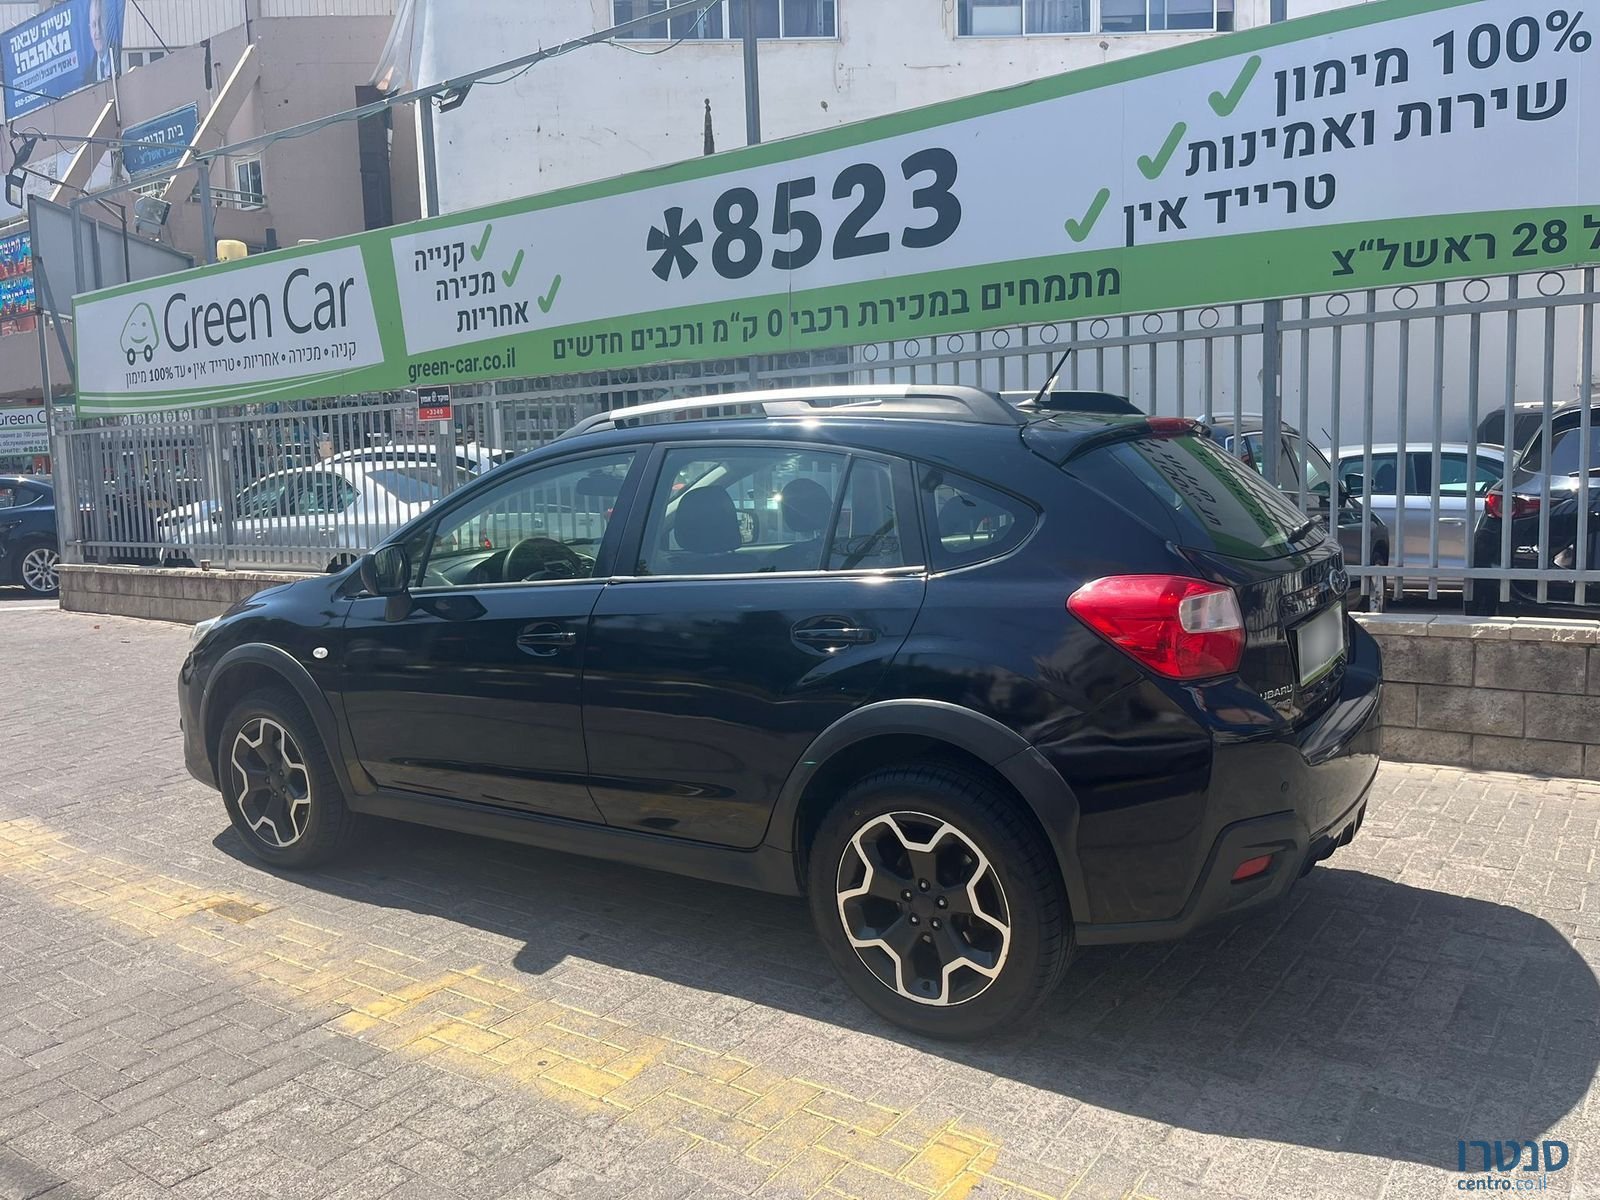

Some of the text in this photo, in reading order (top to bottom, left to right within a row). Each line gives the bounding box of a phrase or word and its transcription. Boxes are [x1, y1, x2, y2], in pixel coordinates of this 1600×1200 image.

[10, 8, 72, 53] עשייה שבאה
[14, 30, 72, 74] מאהבה!
[1274, 9, 1593, 117] 100% מימון
[1185, 78, 1568, 178] שירות ואמינות
[1123, 173, 1336, 248] טרייד אין
[415, 242, 465, 272] קנייה
[1512, 219, 1567, 257] 28
[436, 271, 495, 301] מכירה
[981, 267, 1120, 311] מתמחים
[164, 268, 354, 352] Green Car
[457, 301, 529, 333] אחריות
[767, 308, 783, 337] 0
[791, 305, 848, 334] רכבי
[858, 288, 970, 328] במכירת
[553, 332, 623, 360] חדשים
[631, 322, 704, 352] ורכבים
[125, 341, 357, 388] קניה מכירה אחריות טרייד אין עד 100% מימון
[408, 347, 516, 383] green-car.co.il
[1260, 684, 1293, 701] UBARU
